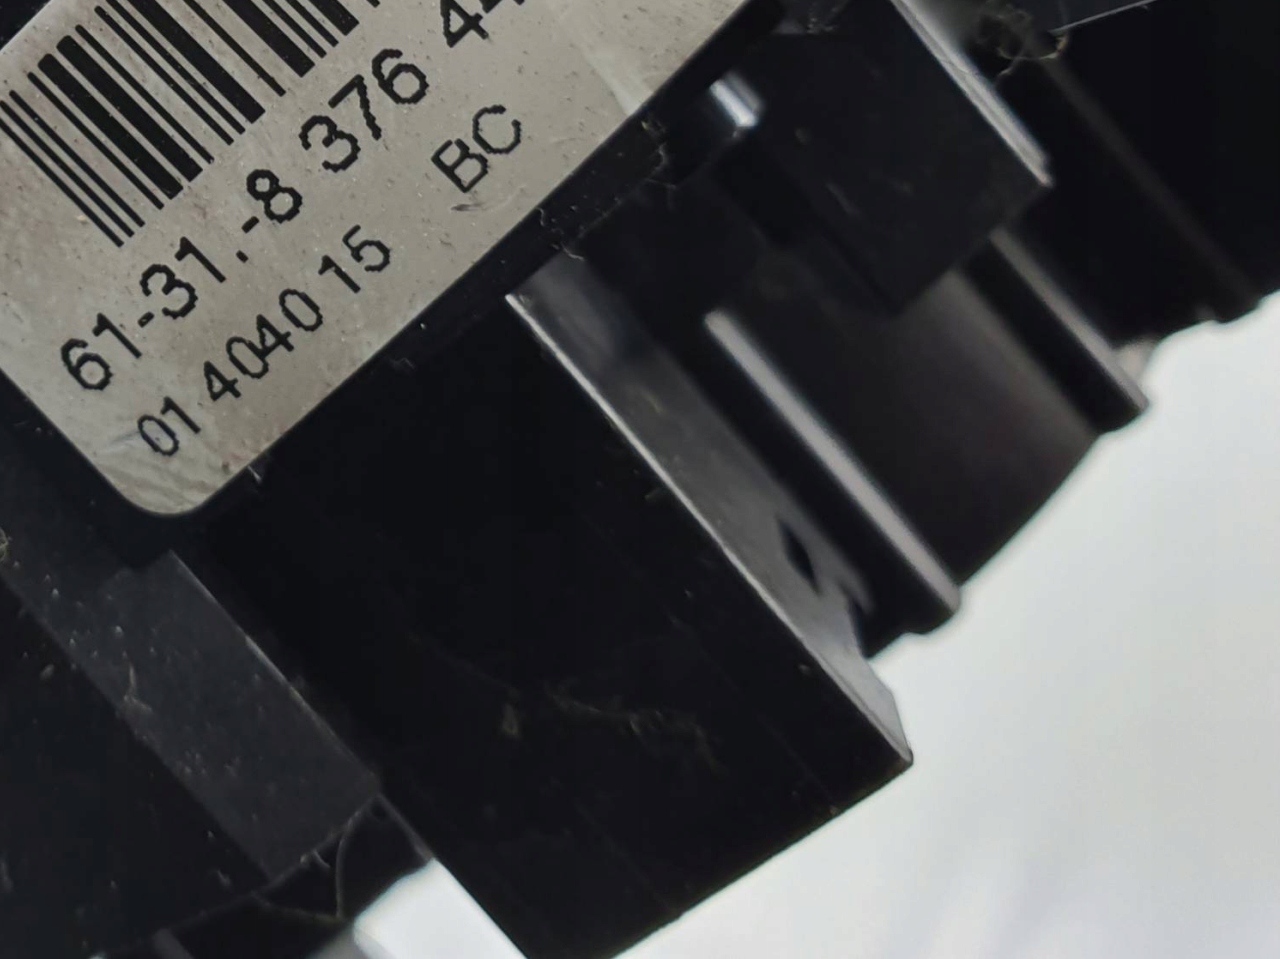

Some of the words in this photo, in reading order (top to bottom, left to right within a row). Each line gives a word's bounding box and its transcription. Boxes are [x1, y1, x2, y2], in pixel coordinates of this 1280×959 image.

[61, 169, 302, 390] 61-31.-8
[300, 48, 428, 172] 376
[138, 396, 200, 456] 01
[202, 288, 322, 402] 4040
[319, 225, 391, 293] 15
[431, 105, 521, 193] BC
